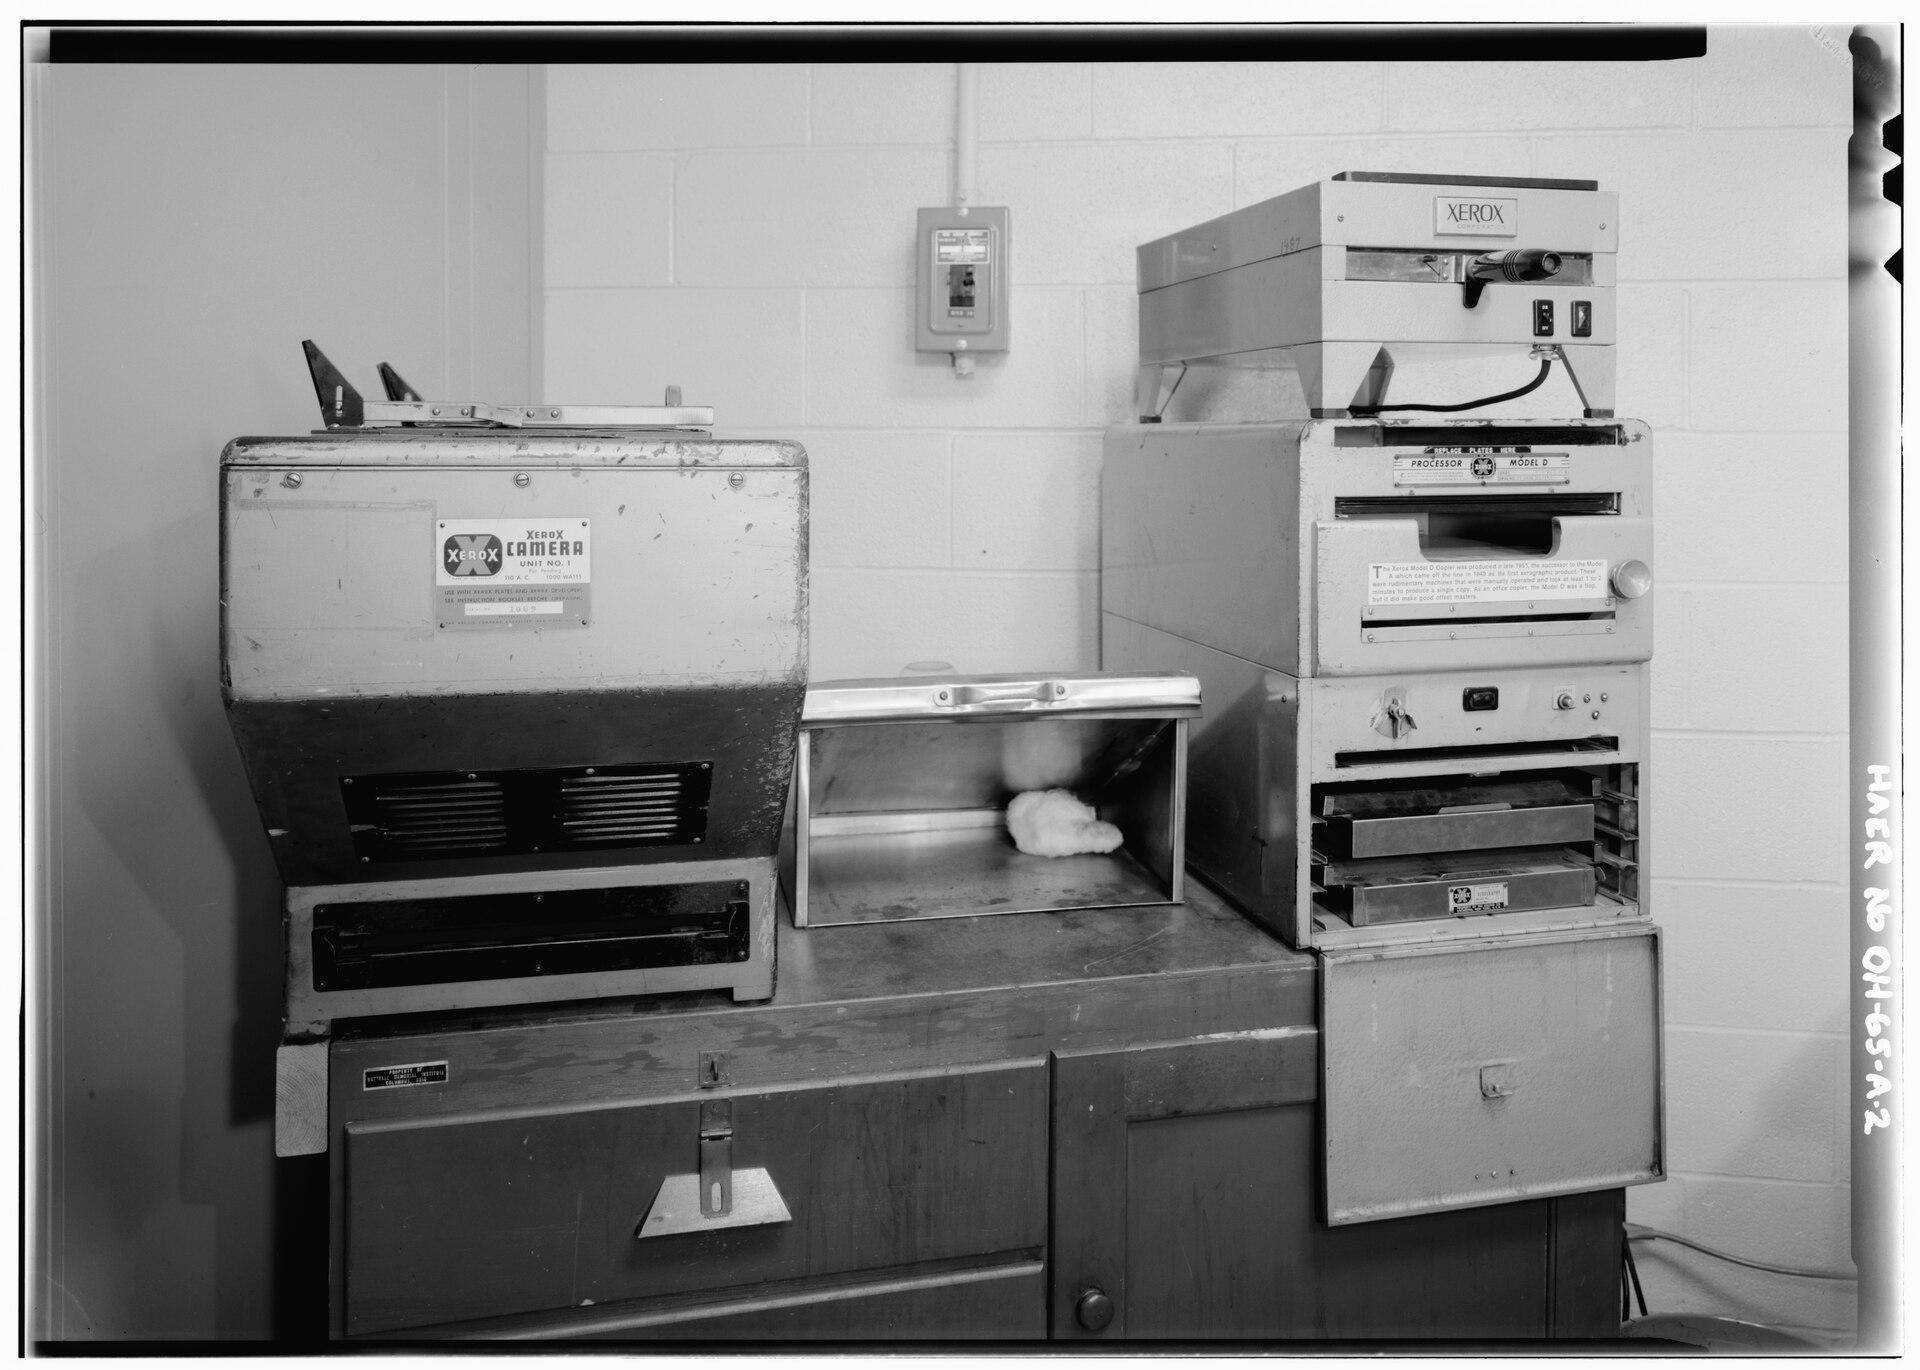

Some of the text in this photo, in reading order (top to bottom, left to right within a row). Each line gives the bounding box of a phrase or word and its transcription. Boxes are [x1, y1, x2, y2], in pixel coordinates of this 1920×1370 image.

[1448, 204, 1504, 224] XEROX
[1411, 460, 1462, 468] PROCESSOR
[527, 530, 564, 540] XEROX
[506, 541, 584, 556] CAMERA
[448, 549, 498, 562] XEROX
[1436, 564, 1454, 572] Copier
